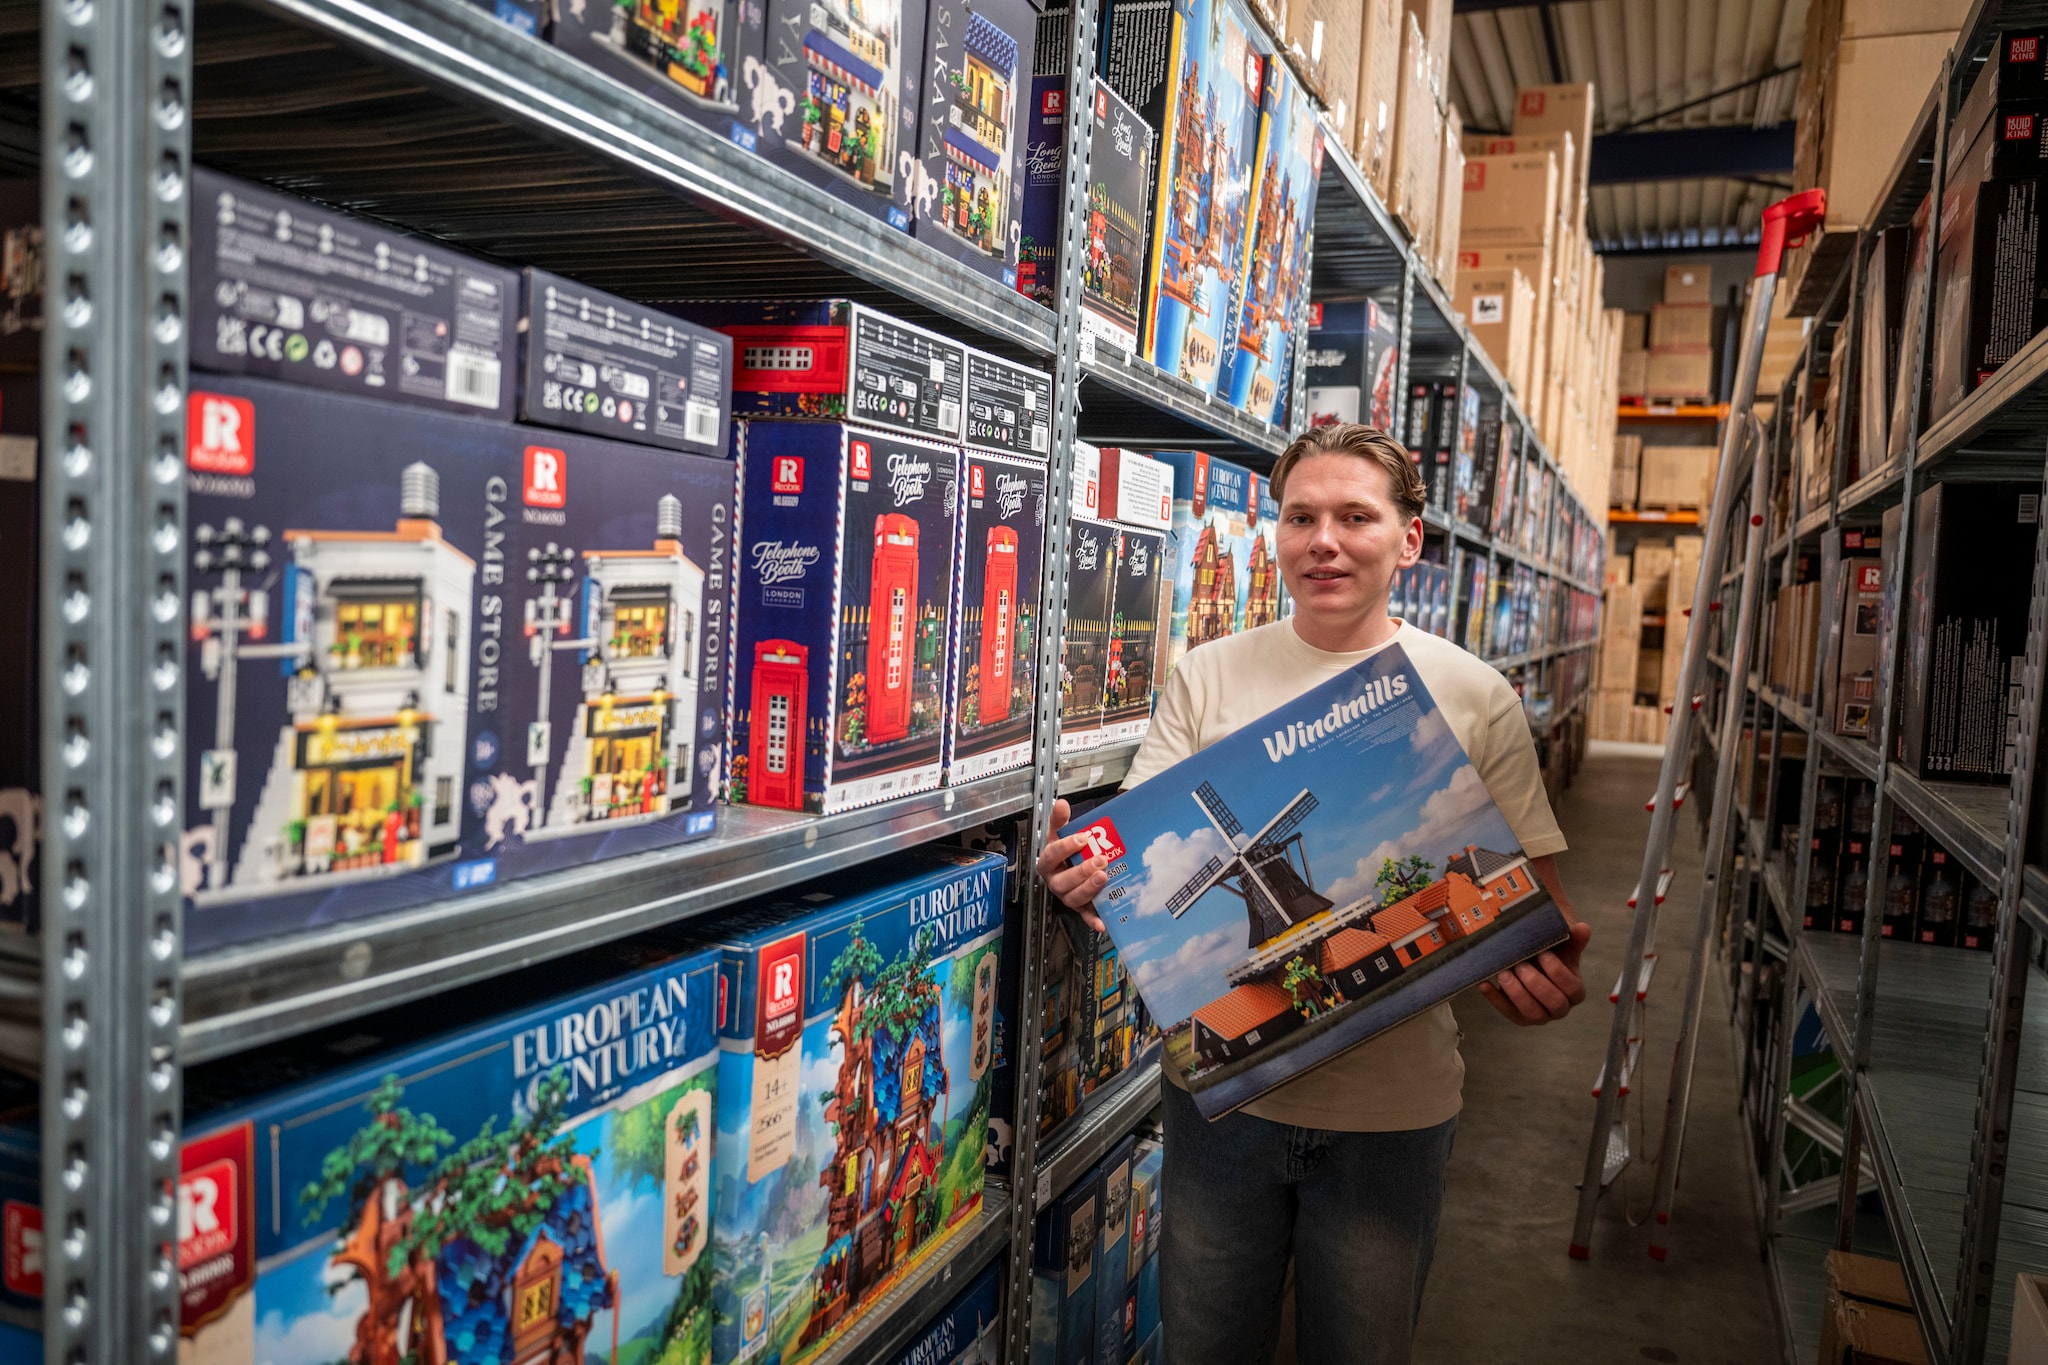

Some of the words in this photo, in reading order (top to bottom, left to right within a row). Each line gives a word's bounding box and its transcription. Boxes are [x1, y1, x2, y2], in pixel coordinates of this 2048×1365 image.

[2011, 53, 2034, 61] KING
[2012, 40, 2036, 53] MOULD
[928, 5, 951, 160] SAKAYA
[1111, 107, 1132, 141] Long
[2006, 130, 2029, 138] KING
[2007, 117, 2031, 131] MOULD
[1025, 141, 1062, 166] Long
[1115, 135, 1133, 160] Bench
[886, 454, 932, 487] Telephone
[937, 466, 954, 475] LONDON
[1212, 467, 1241, 488] EUROPEAN
[894, 476, 925, 507] Booth
[996, 473, 1028, 503] Telephone
[1212, 483, 1239, 505] CENTURY
[1000, 491, 1023, 520] Booth
[481, 475, 508, 586] GAME
[1075, 528, 1098, 558] Long
[708, 502, 726, 591] GAME
[751, 540, 821, 569] Telephone
[759, 559, 807, 585] Booth
[765, 590, 801, 599] LONDON
[476, 595, 503, 714] STORE
[703, 598, 722, 693] STORE
[1262, 674, 1410, 763] Windmills
[1104, 847, 1123, 860] brix
[909, 869, 991, 927] EUROPEAN
[1108, 886, 1127, 901] 4801
[914, 898, 986, 952] CNTURY
[1085, 953, 1095, 1040] RESTAURANT
[513, 973, 688, 1079] EUROPEAN
[525, 1016, 679, 1114] CNTURY
[765, 1078, 788, 1100] 14+
[899, 1313, 955, 1365] UROPEAN
